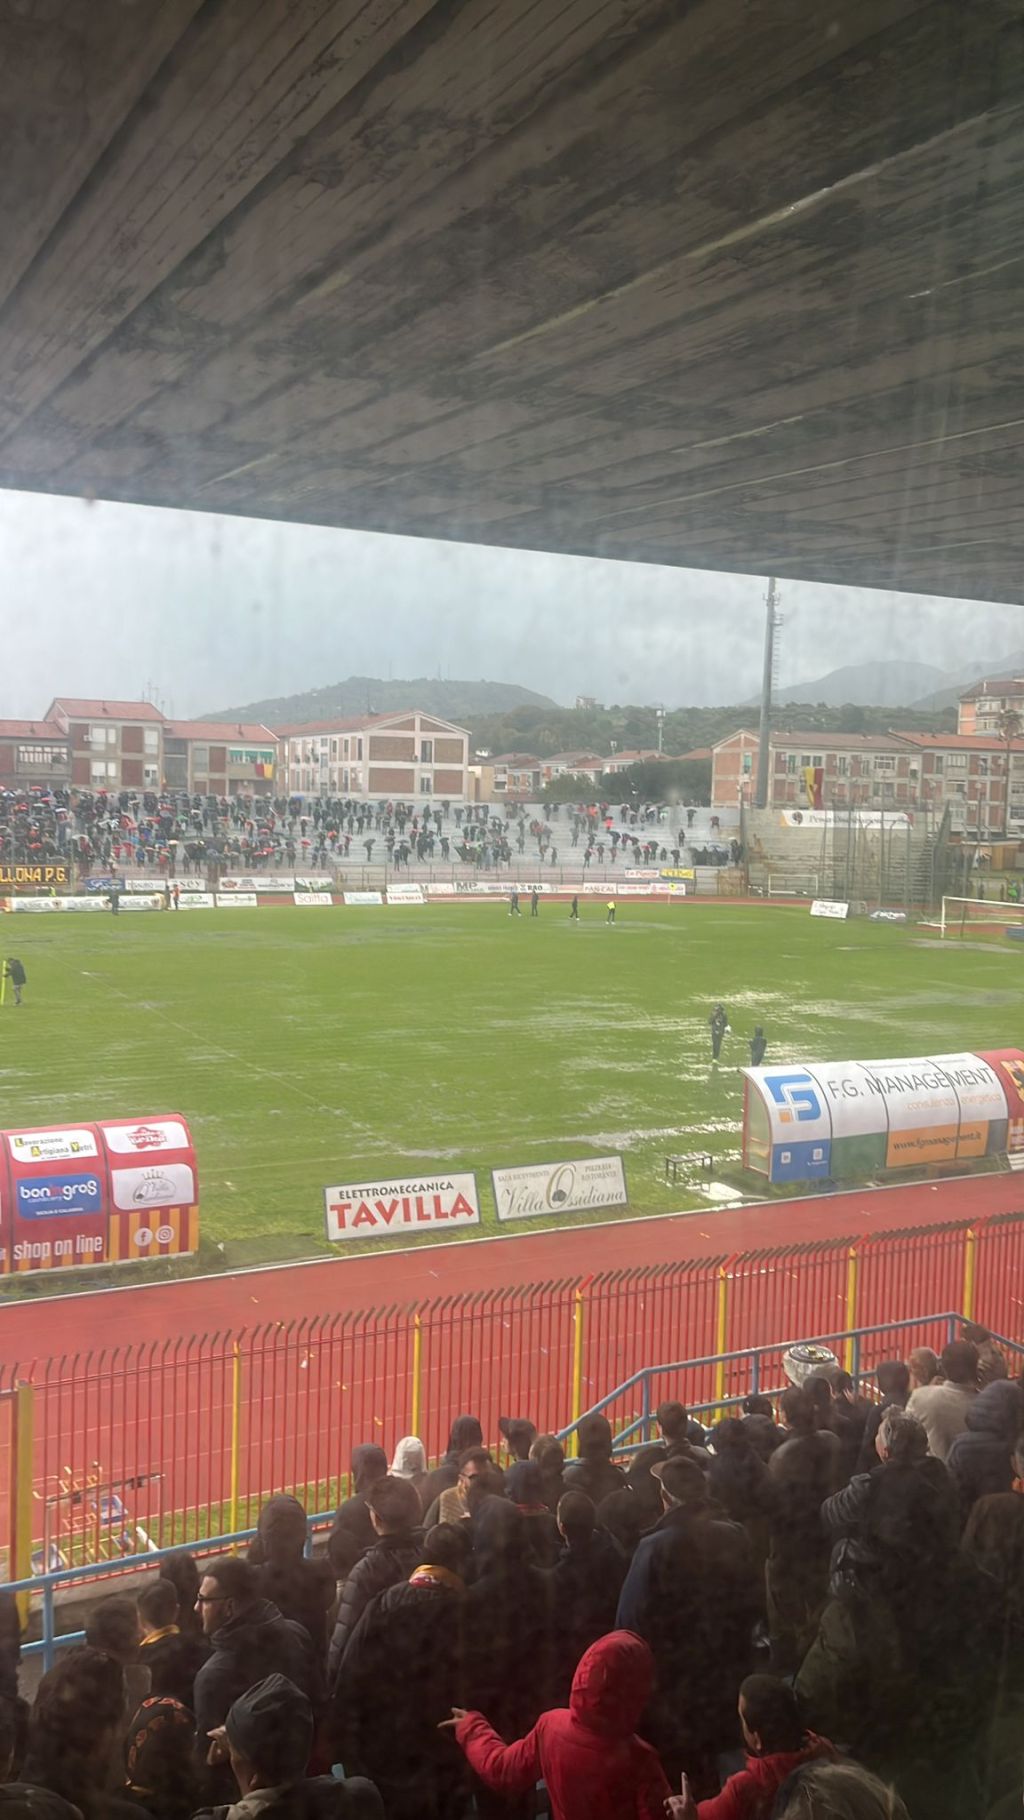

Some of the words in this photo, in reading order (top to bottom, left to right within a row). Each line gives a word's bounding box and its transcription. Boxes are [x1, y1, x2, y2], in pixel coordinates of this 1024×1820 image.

[45, 867, 68, 882] P.G.
[827, 1078, 864, 1100] F.G.
[865, 1067, 994, 1097] MANAGEMENT
[70, 1142, 94, 1153] Vetri
[339, 1181, 454, 1200] ELETTROMECCANICA
[500, 1185, 544, 1216] Villa
[546, 1163, 624, 1210] Ossidiana
[329, 1191, 475, 1230] TAVILLA
[13, 1240, 51, 1260] shop
[54, 1238, 73, 1257] on
[75, 1234, 103, 1254] line
